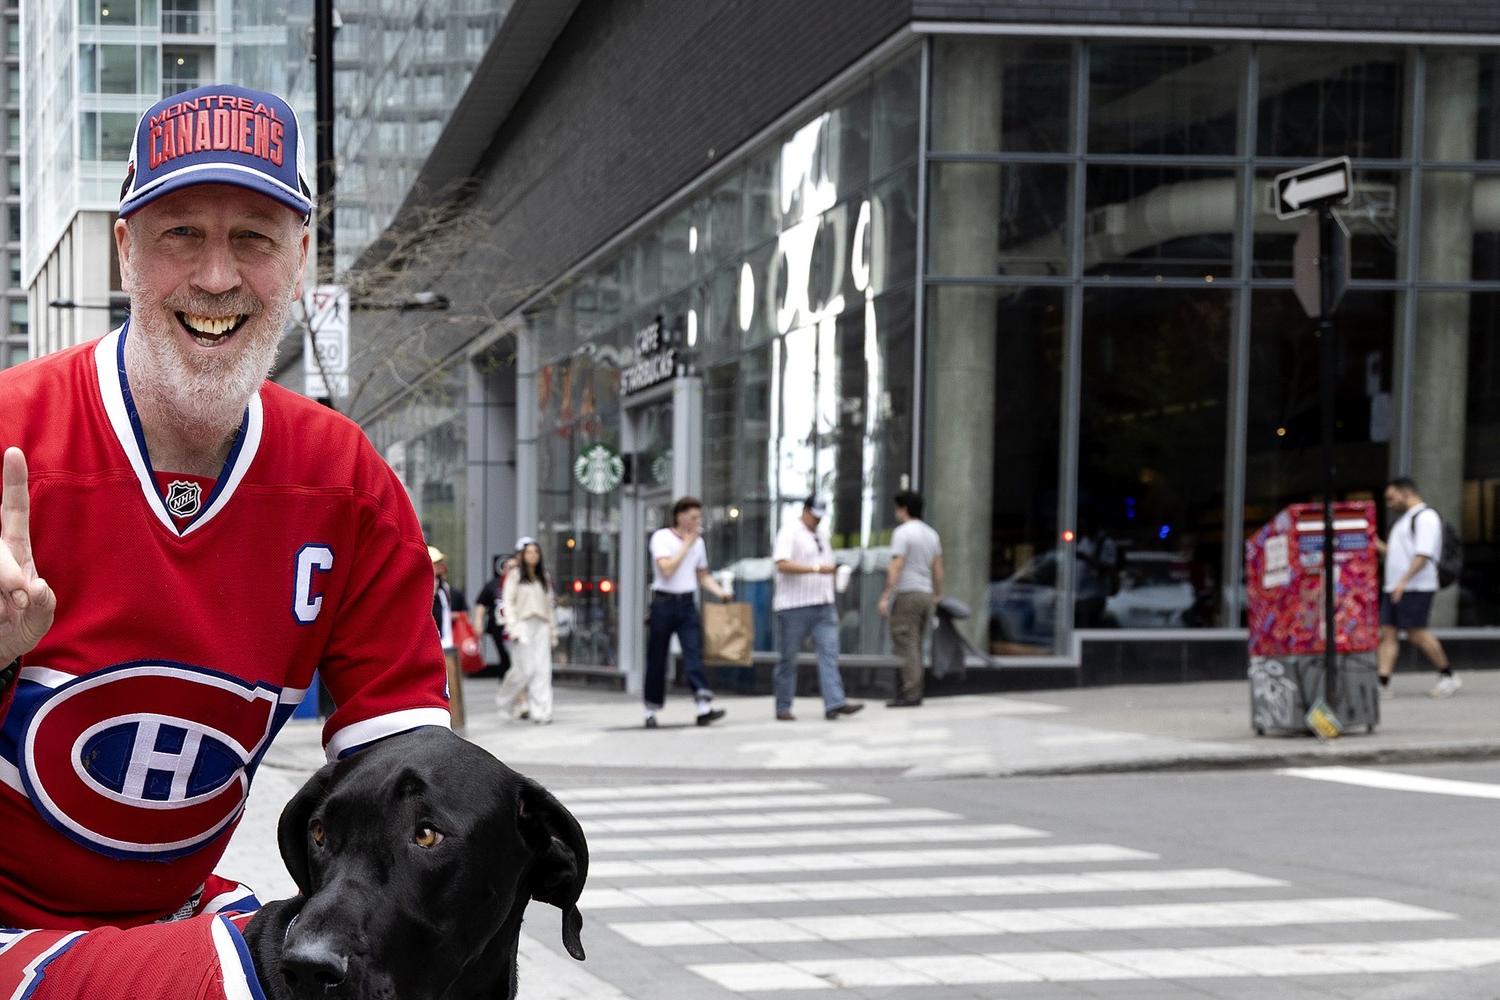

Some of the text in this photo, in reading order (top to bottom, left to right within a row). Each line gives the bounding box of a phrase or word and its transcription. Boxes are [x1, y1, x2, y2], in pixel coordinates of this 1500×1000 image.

[150, 95, 284, 128] MONTREAL
[149, 108, 284, 170] CANADIENS
[173, 491, 195, 508] NHL
[293, 545, 334, 624] C
